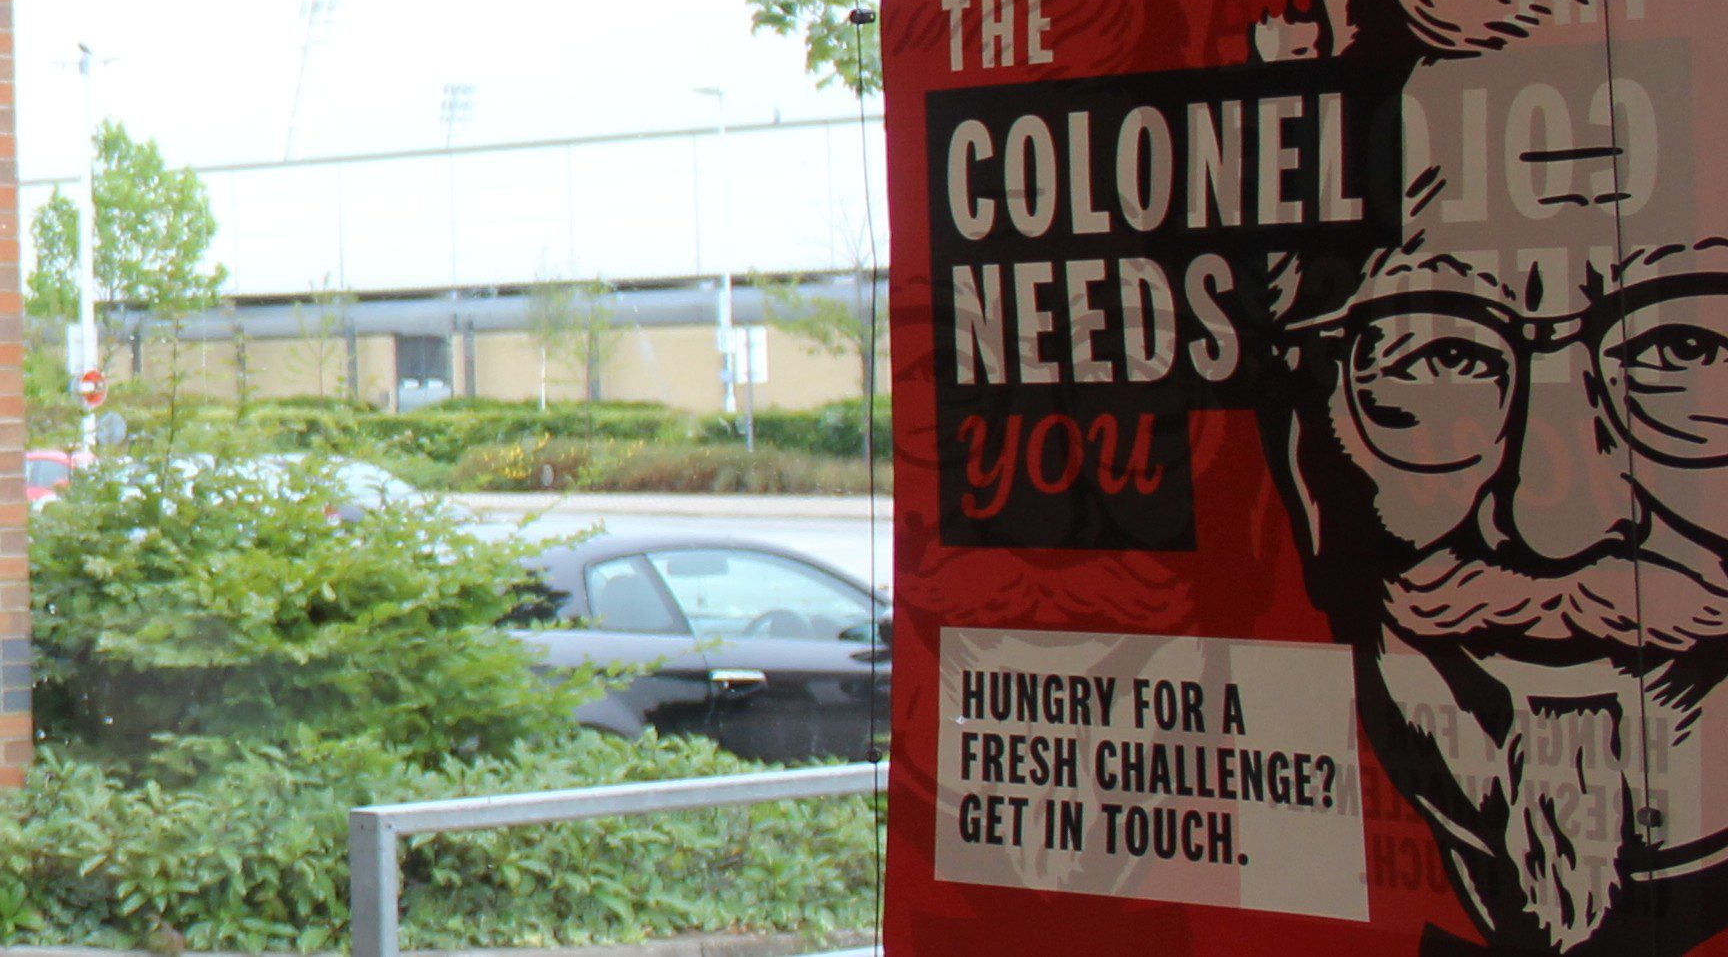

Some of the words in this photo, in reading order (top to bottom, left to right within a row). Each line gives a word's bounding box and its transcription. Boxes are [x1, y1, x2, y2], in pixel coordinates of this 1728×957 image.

[947, 92, 1364, 241] COLONEL
[954, 253, 1241, 386] NEEDS
[957, 411, 1163, 520] you
[961, 669, 1117, 727] HUNGRY
[1132, 677, 1205, 733] FOR
[1222, 683, 1247, 735] A
[960, 731, 1078, 788] FRESH
[1095, 739, 1337, 809] CHALLENGE?
[959, 793, 1029, 846] GET
[1045, 799, 1084, 852] IN
[1101, 803, 1249, 866] TOUCH.
